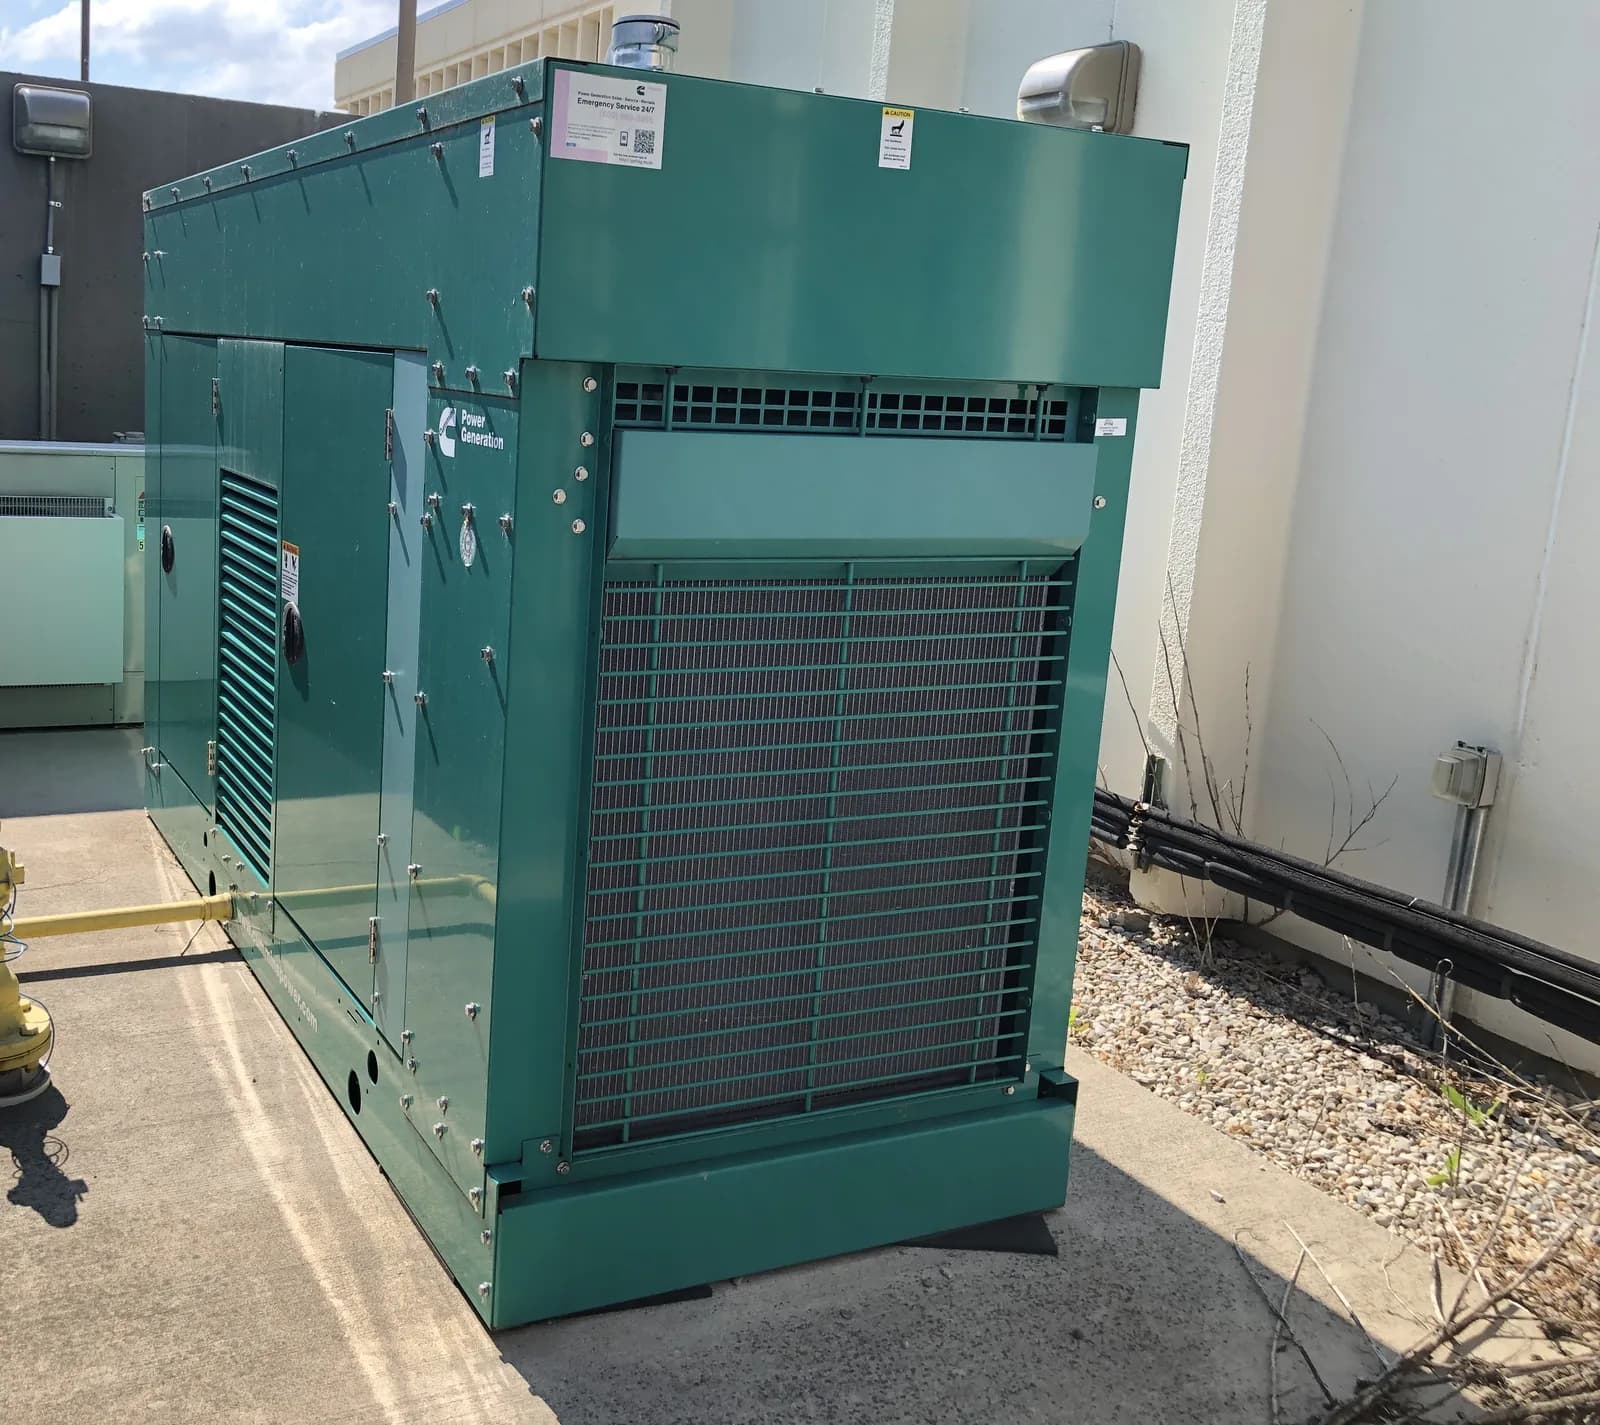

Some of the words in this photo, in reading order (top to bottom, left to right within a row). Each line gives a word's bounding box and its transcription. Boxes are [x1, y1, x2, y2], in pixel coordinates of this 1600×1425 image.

[577, 97, 614, 110] Emergency
[616, 103, 641, 112] Service
[461, 409, 486, 429] Power
[461, 427, 504, 450] Generation
